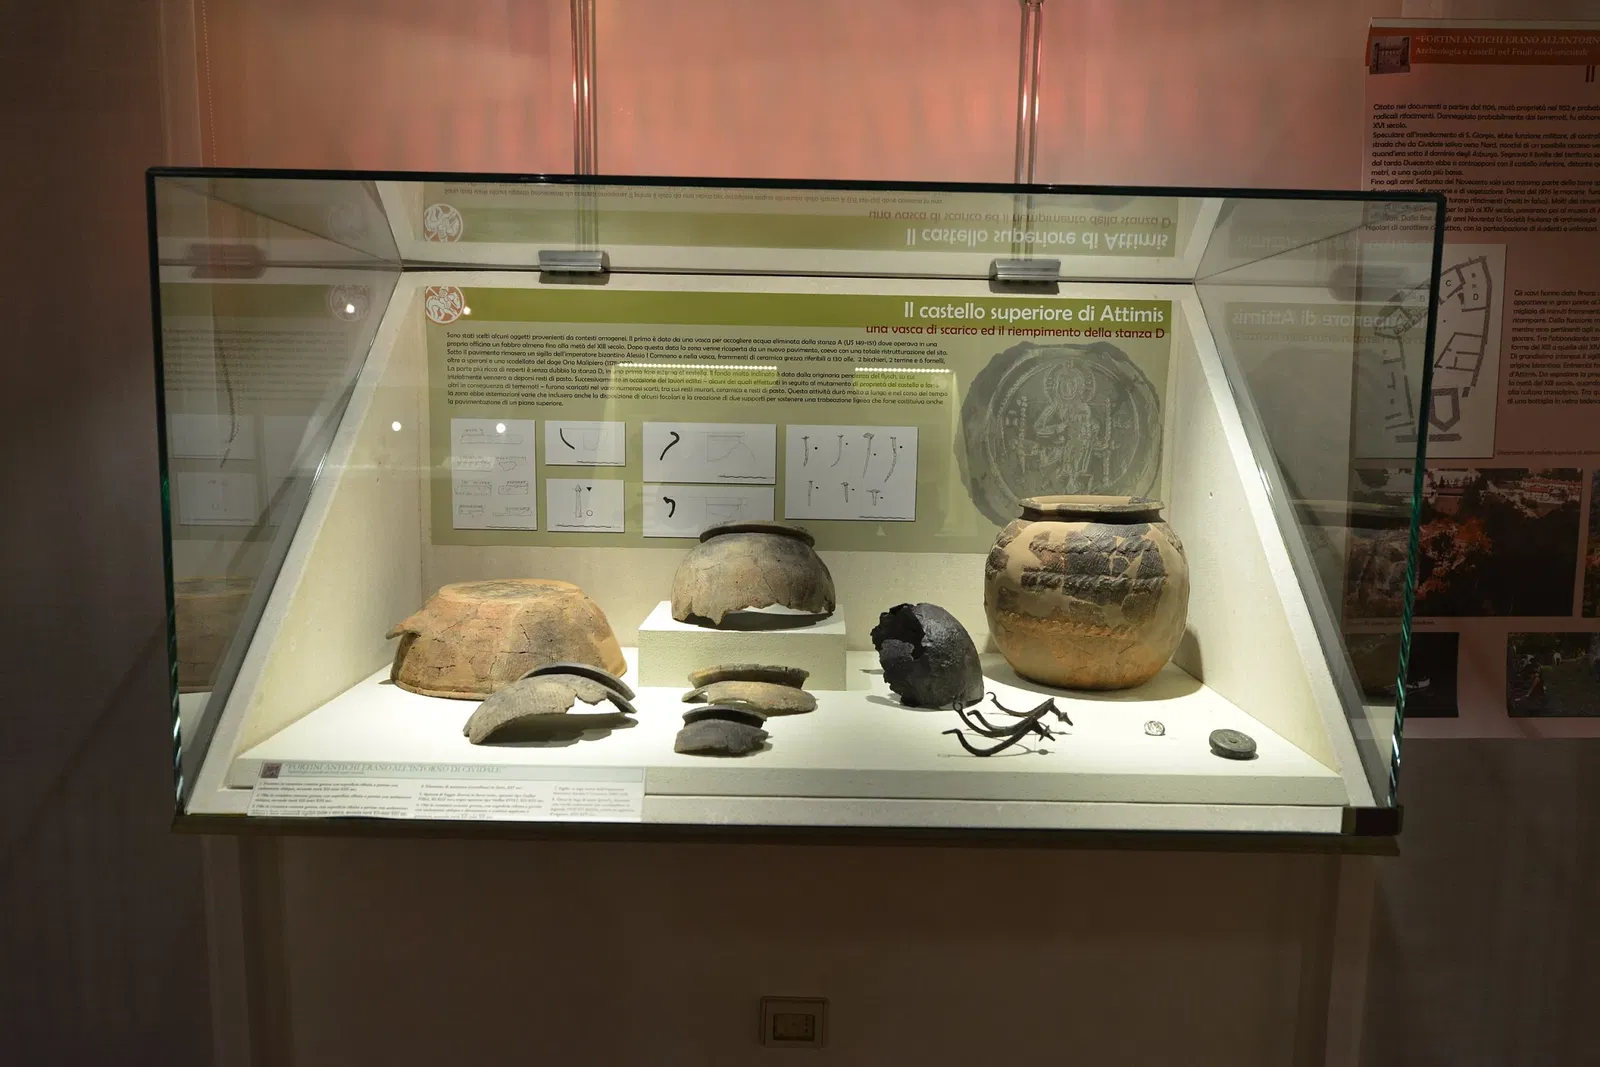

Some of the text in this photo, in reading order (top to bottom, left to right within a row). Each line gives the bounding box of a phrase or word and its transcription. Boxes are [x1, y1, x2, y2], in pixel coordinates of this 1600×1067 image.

[1416, 48, 1461, 56] Archeologia
[1469, 48, 1496, 56] castelli
[1498, 48, 1510, 56] nel
[1512, 48, 1532, 56] Friuli
[1449, 103, 1469, 112] partire
[1516, 104, 1546, 112] proprietà
[1371, 168, 1390, 177] metri,
[1412, 169, 1432, 177] quota
[1433, 169, 1444, 177] più
[1386, 178, 1398, 186] agli
[1542, 179, 1559, 187] parte
[904, 302, 1164, 323] Il castello superiore di Attimis
[866, 324, 1164, 338] una vasca di scarico ed il riempimento della stanza D
[510, 332, 531, 341] oggetti
[532, 333, 565, 342] provenienti
[634, 334, 651, 343] primo
[723, 336, 752, 345] accogliere
[844, 338, 854, 346] (US
[447, 340, 468, 348] propria
[627, 343, 643, 351] Dopo
[644, 343, 664, 352] questa
[722, 345, 747, 353] ricoperta
[787, 346, 820, 354] pavimento,
[882, 347, 925, 355] ristrutturazione
[454, 398, 501, 407] pavimentazione
[518, 398, 535, 407] piano
[536, 399, 564, 407] superiore.
